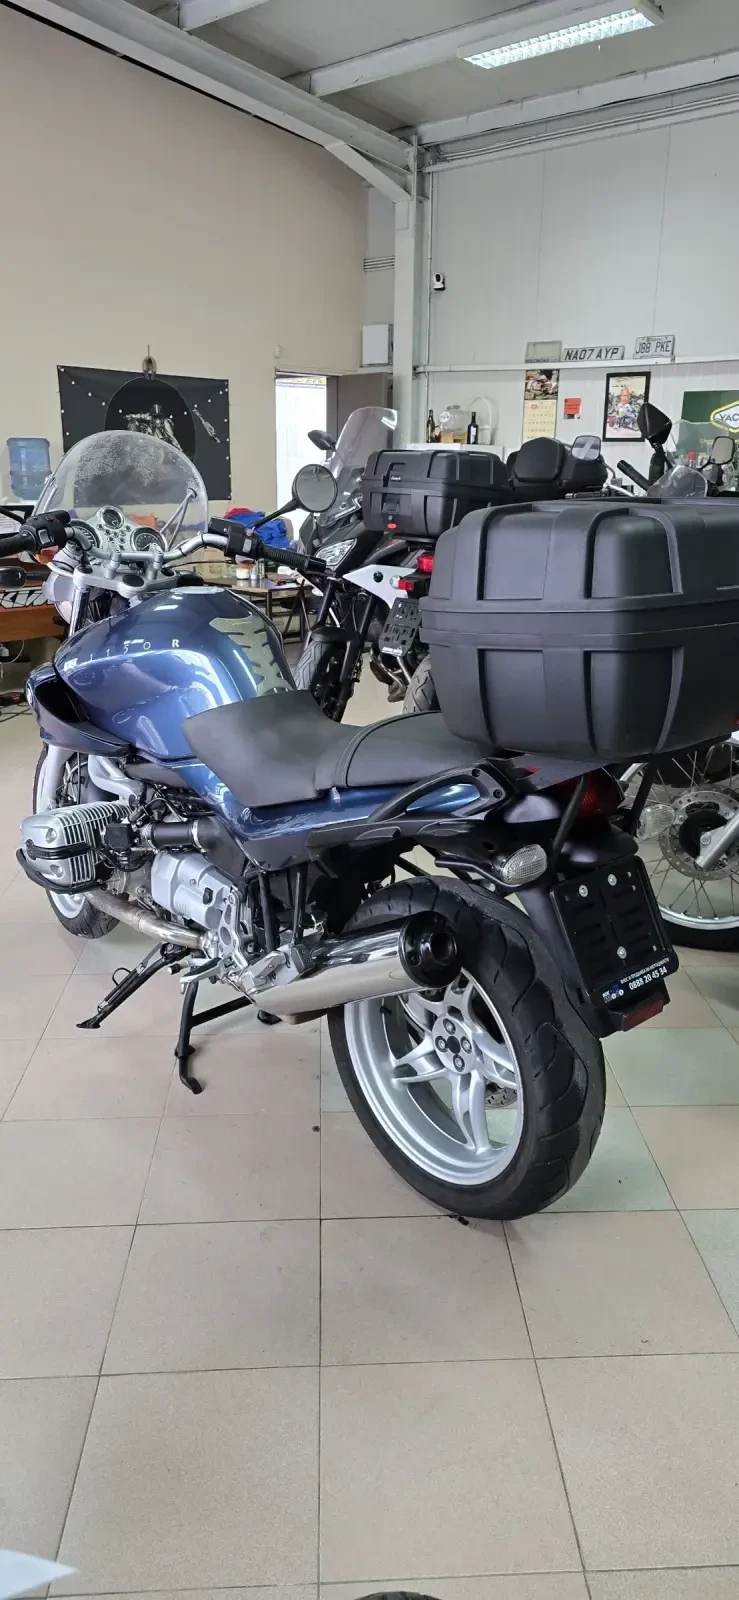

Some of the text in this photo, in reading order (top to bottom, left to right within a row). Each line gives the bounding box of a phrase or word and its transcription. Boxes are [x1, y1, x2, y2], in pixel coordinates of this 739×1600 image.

[655, 340, 671, 353] PKE
[565, 348, 619, 361] NA07 AYP
[171, 639, 180, 648] R
[629, 966, 668, 990] 0888 20 45 34
